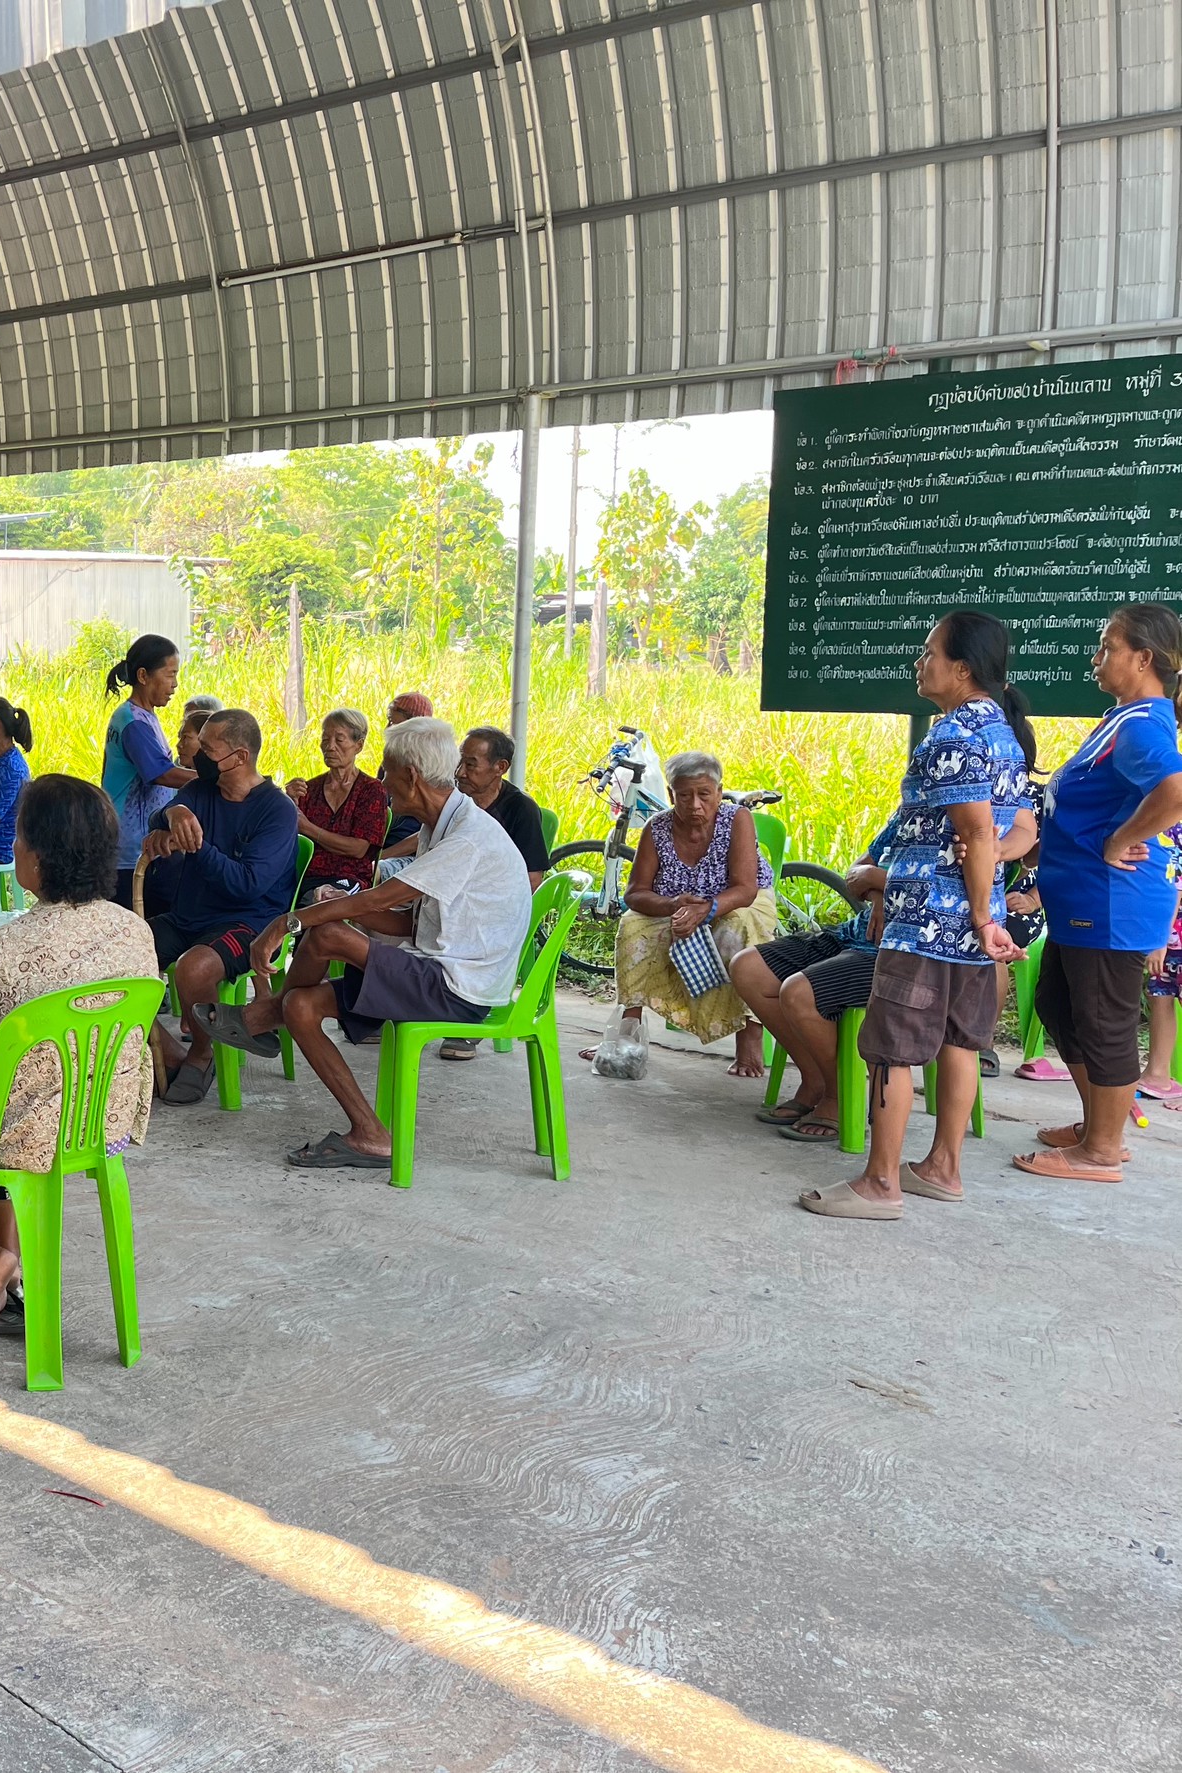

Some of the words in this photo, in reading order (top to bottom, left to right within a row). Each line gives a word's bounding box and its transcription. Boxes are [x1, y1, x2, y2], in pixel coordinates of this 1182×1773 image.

[1126, 365, 1162, 397] หมู่ที่
[1016, 472, 1030, 481] คน
[920, 494, 938, 504] บาท
[1061, 645, 1079, 654] 500
